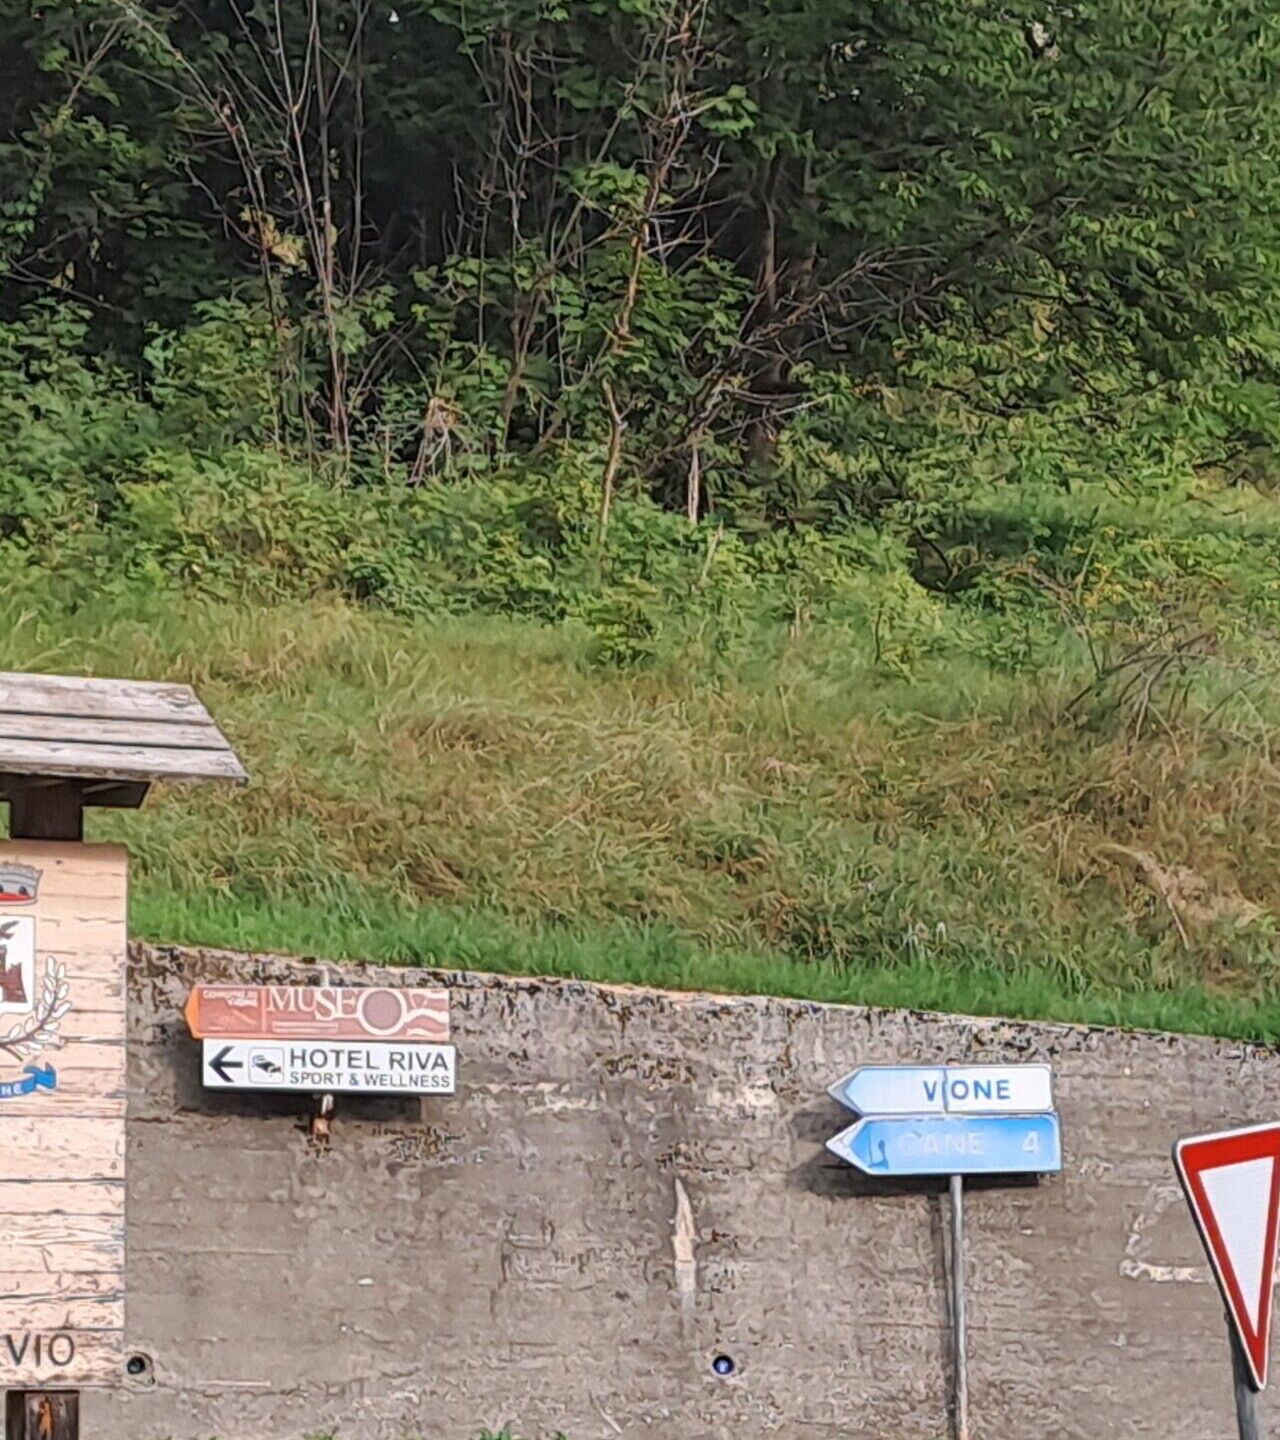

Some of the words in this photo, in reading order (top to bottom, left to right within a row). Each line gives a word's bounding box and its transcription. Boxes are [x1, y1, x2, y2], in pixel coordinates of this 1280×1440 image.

[267, 986, 407, 1036] MUSEO
[290, 1048, 380, 1070] HOTEL
[389, 1051, 449, 1071] RIVA
[290, 1071, 343, 1085] SPORT
[349, 1072, 359, 1086] &
[364, 1073, 451, 1088] WELLNESS
[923, 1079, 1011, 1100] VIONE
[1022, 1130, 1040, 1153] 4
